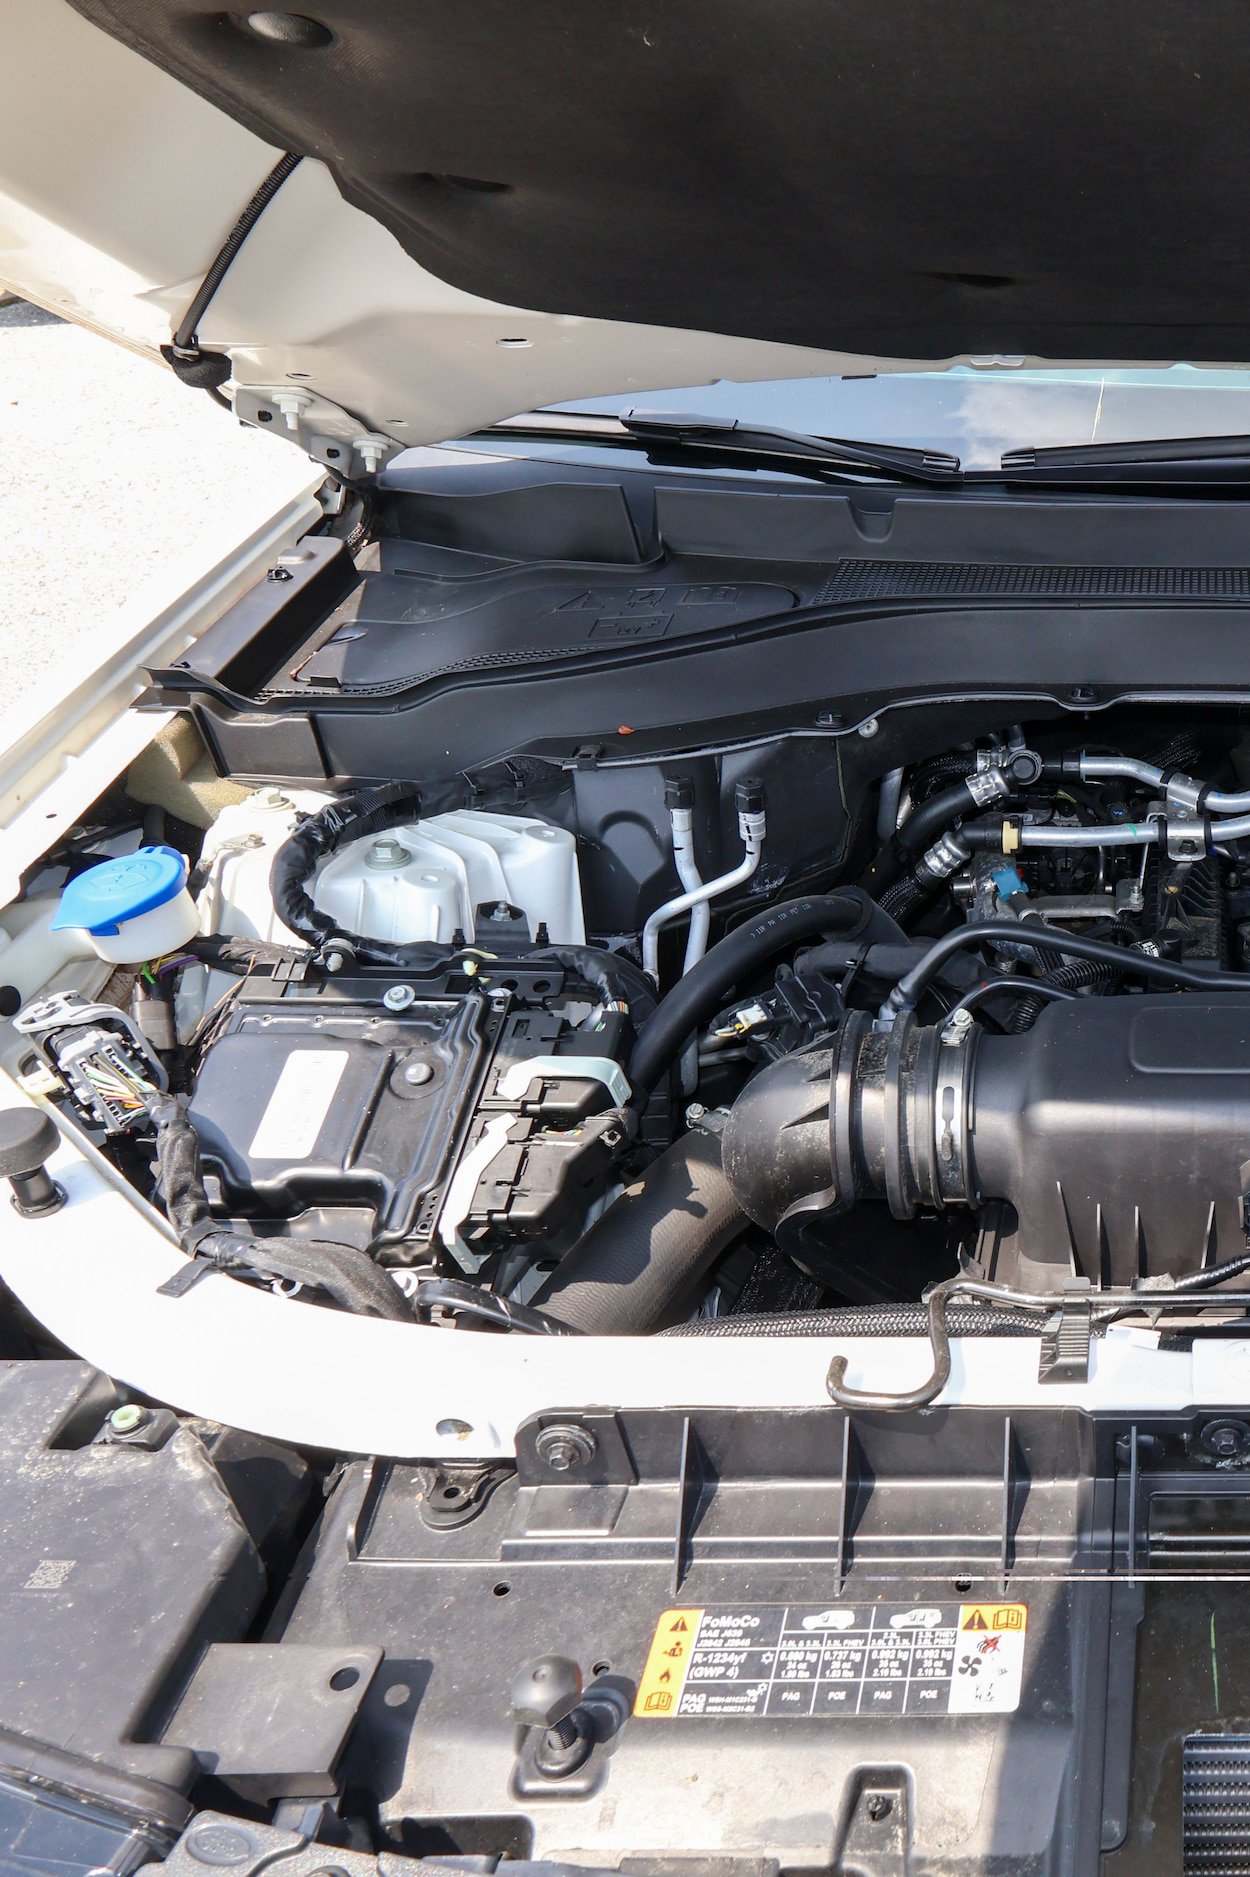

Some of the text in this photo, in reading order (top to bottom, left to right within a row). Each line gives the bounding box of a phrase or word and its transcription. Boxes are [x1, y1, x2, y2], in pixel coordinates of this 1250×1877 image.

[702, 1614, 760, 1628] FoMoCo
[700, 1629, 743, 1638] SAE J639
[692, 1652, 748, 1666] R-1234yf
[806, 1651, 818, 1662] kg
[824, 1651, 862, 1662] 0.737 kg
[897, 1650, 909, 1661] kg
[941, 1649, 953, 1660] kg
[786, 1661, 808, 1670] 24 oz
[878, 1660, 900, 1668] 35 oz
[934, 1660, 944, 1668] oz
[689, 1666, 740, 1680] (GWP 4)
[797, 1670, 810, 1678] lbs
[842, 1670, 854, 1678] lbs
[872, 1668, 902, 1677] 2.19 lbs
[917, 1668, 947, 1676] 2.19 lbs
[682, 1694, 707, 1704] PAG
[781, 1692, 800, 1701] PAG
[828, 1691, 846, 1700] POE
[873, 1690, 892, 1700] PAG
[920, 1690, 938, 1699] POE
[679, 1702, 706, 1713] POE
